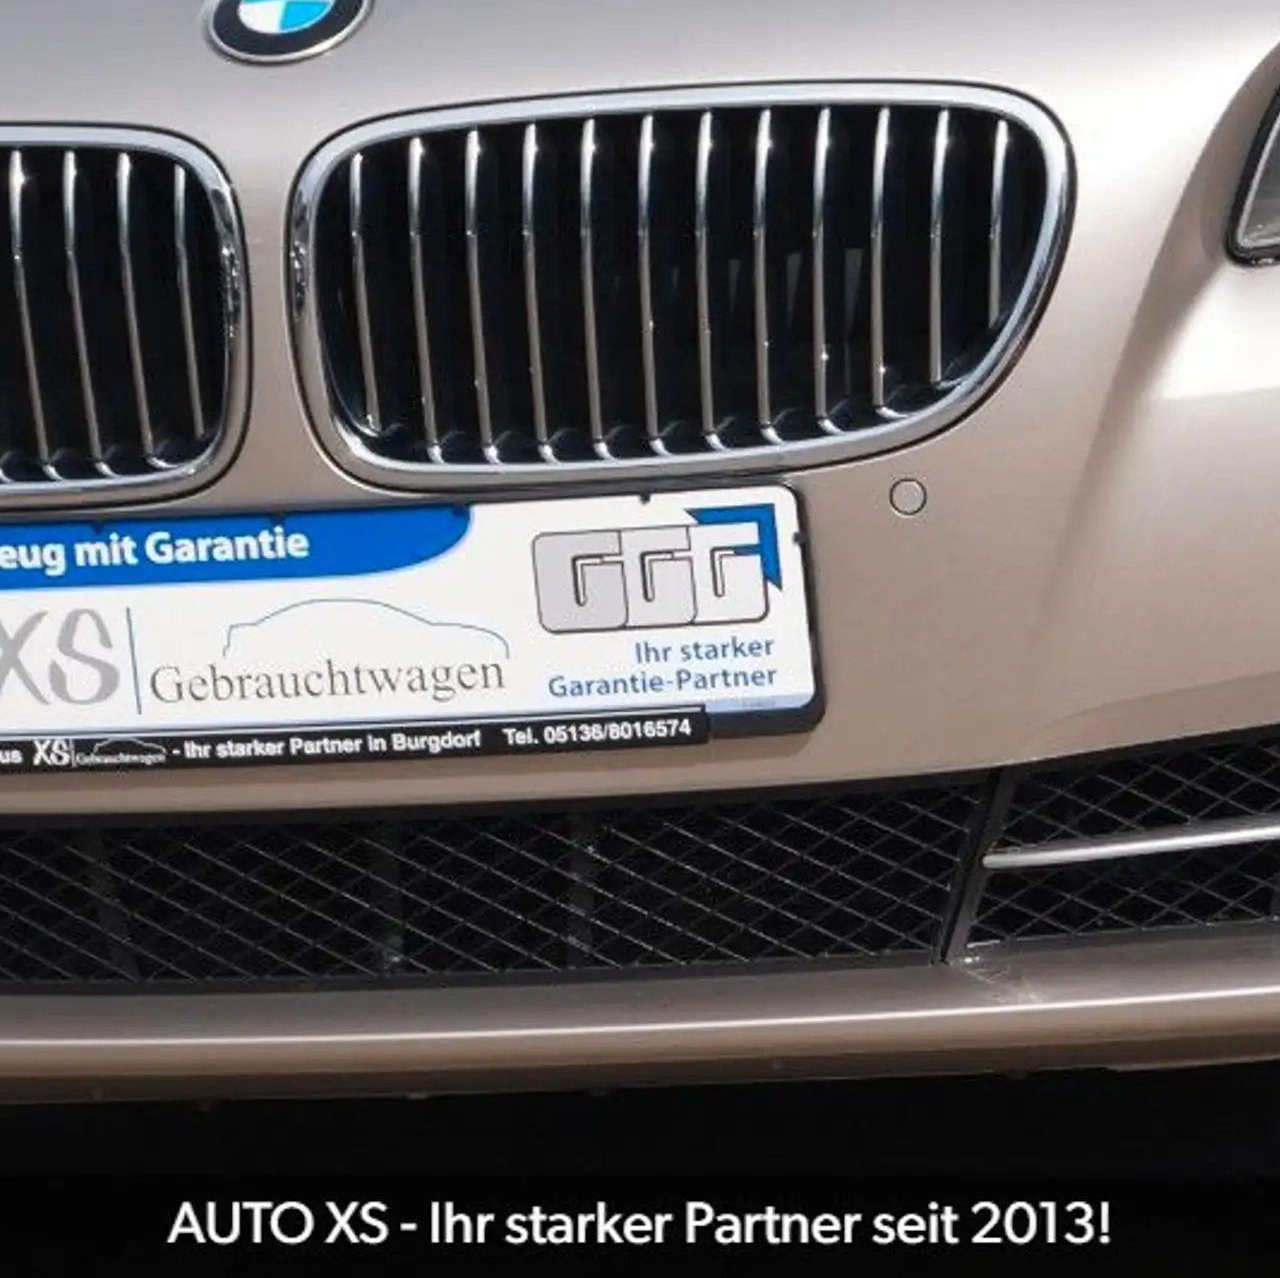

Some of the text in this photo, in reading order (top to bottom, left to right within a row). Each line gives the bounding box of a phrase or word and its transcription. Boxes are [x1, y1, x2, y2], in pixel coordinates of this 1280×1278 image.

[75, 532, 139, 567] mit
[145, 526, 310, 564] Garantie
[634, 636, 776, 665] Ihr starker
[150, 659, 507, 704] Gebrauchtwagen
[548, 666, 778, 699] Garantie-Partner
[32, 739, 70, 766] XS
[184, 740, 212, 759] Ihr
[216, 739, 285, 759] starker
[289, 735, 363, 756] Partner
[367, 734, 387, 752] in
[392, 730, 482, 755] Burgdorf
[502, 727, 539, 746] Tel.
